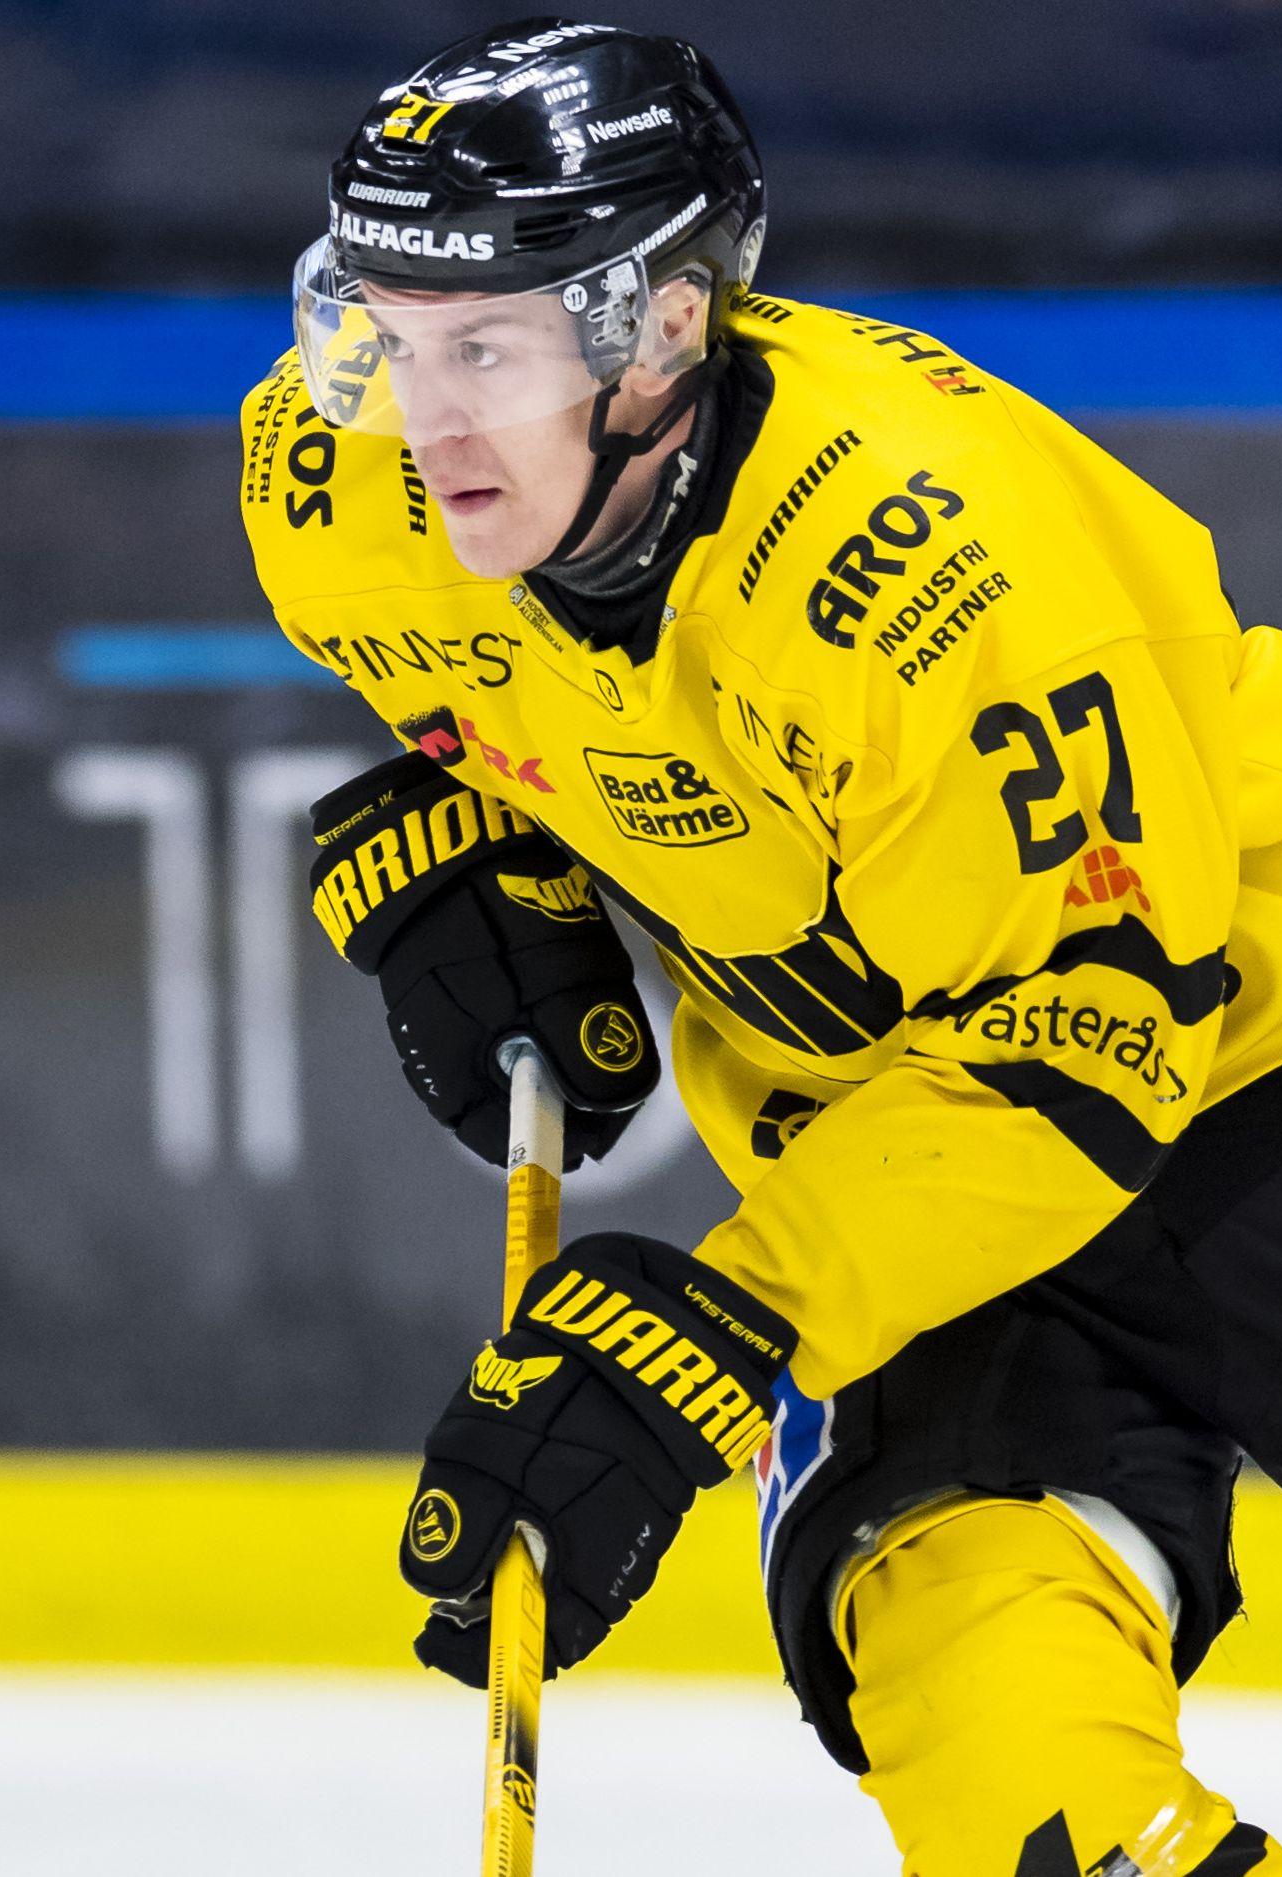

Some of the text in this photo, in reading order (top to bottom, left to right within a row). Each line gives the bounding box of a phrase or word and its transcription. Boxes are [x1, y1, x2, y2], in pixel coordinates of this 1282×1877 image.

[382, 93, 456, 144] 27
[587, 105, 674, 144] Newsafe
[348, 181, 431, 208] WARRIOR
[340, 213, 495, 261] ALFAGLAS
[631, 193, 707, 261] WARRIOR
[738, 429, 862, 605] WARRIOR
[806, 470, 965, 650] AROS
[874, 540, 989, 657] INDUSTRI
[896, 571, 1013, 687] PARTNER
[599, 759, 720, 804] Bad &
[970, 671, 1143, 875] 27
[614, 804, 735, 837] Värme
